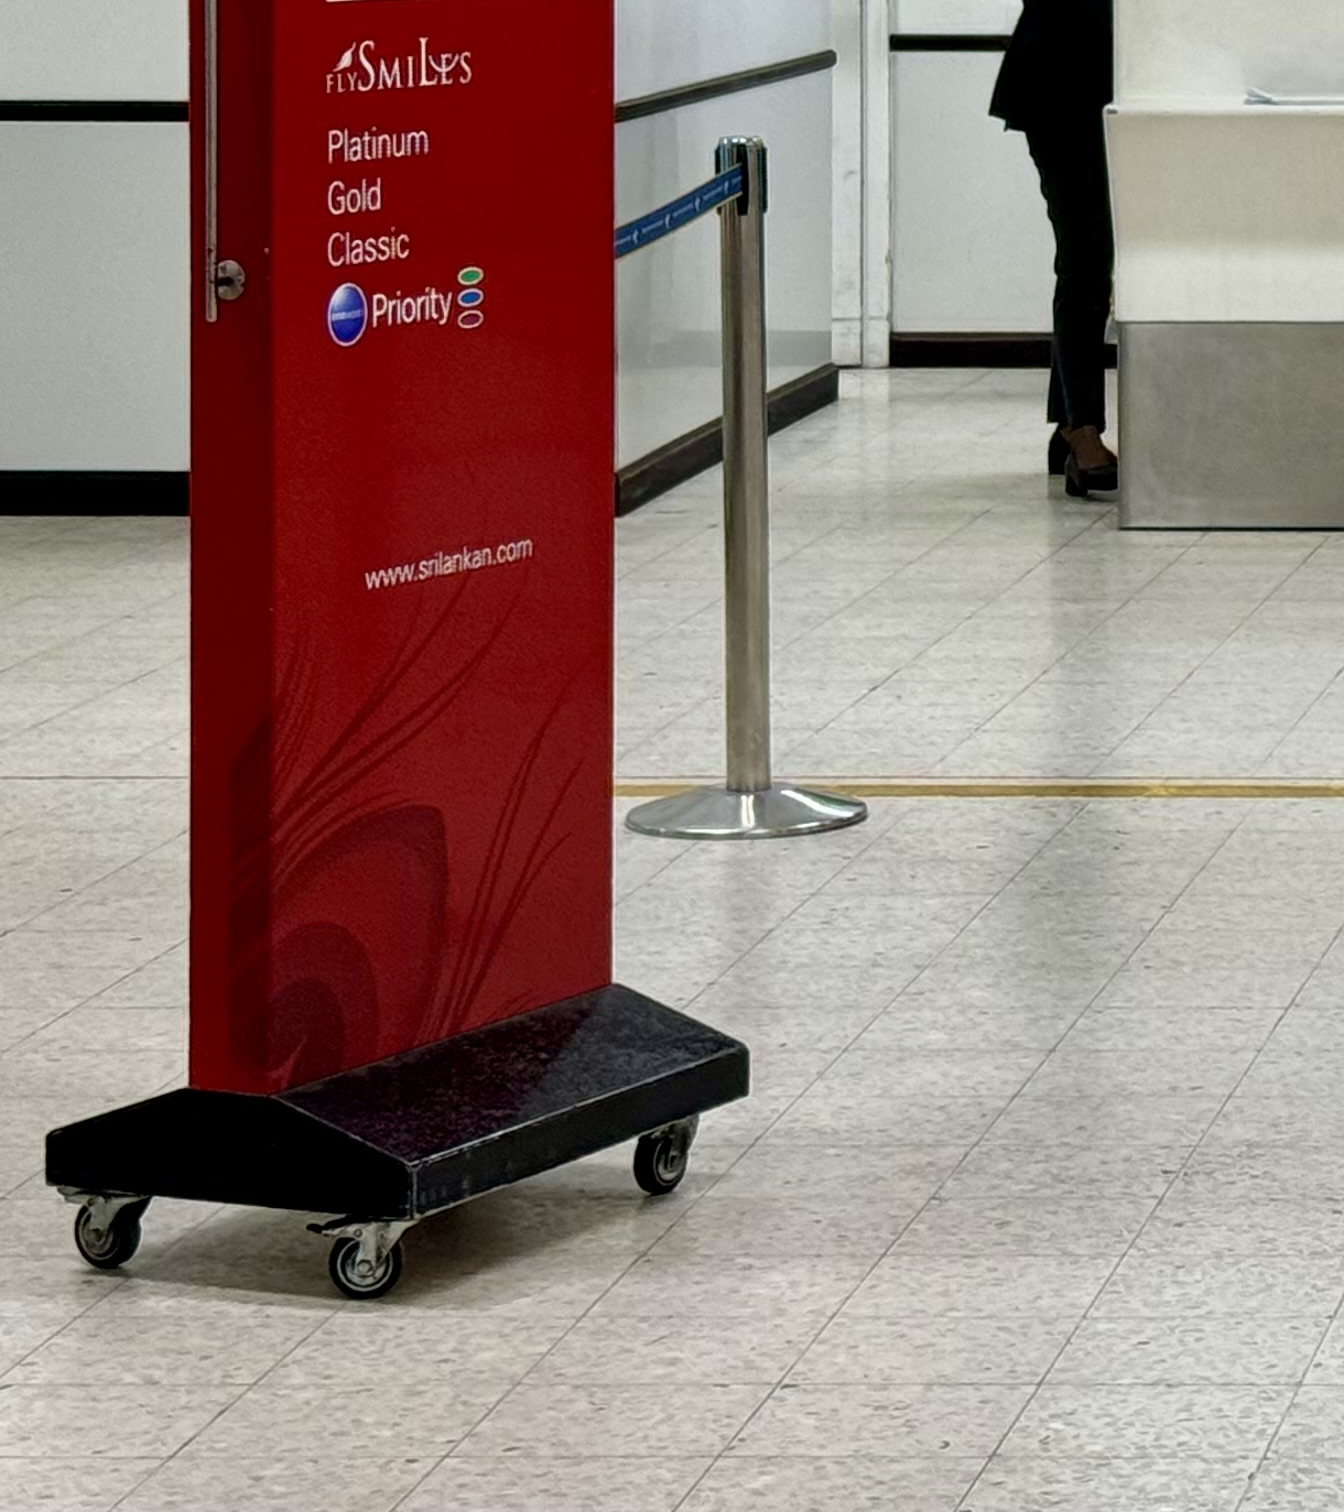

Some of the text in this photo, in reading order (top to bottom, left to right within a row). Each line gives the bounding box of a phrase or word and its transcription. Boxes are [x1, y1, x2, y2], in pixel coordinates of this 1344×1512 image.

[327, 127, 430, 164] Platinum
[327, 178, 382, 216] Gold
[327, 226, 410, 267] Classic
[372, 286, 453, 328] Priority
[365, 539, 533, 591] www.srilankan.com
